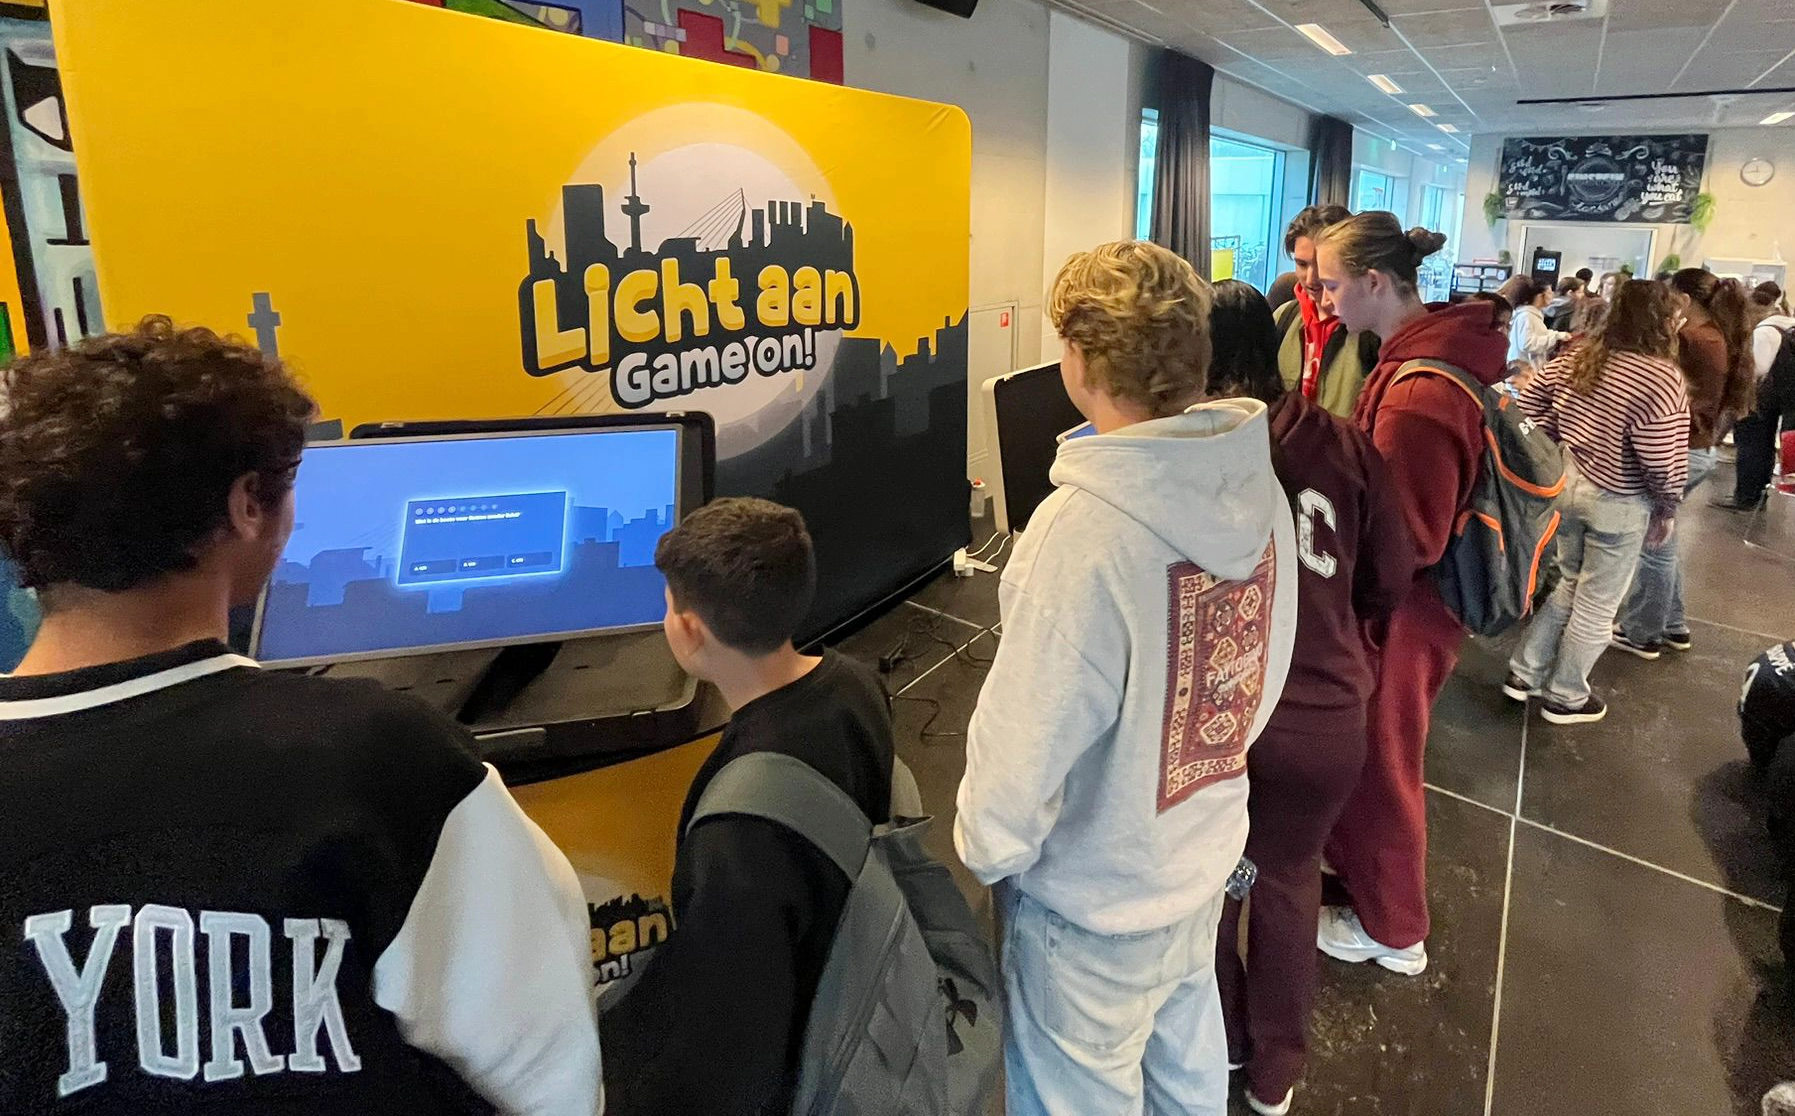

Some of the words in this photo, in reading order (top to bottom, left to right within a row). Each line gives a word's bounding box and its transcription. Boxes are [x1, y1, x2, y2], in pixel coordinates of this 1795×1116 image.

[533, 257, 746, 370] Licht
[756, 264, 854, 327] aan
[615, 337, 747, 404] Game
[755, 327, 814, 373] on!
[1297, 488, 1337, 579] C
[24, 903, 362, 1097] YORK
